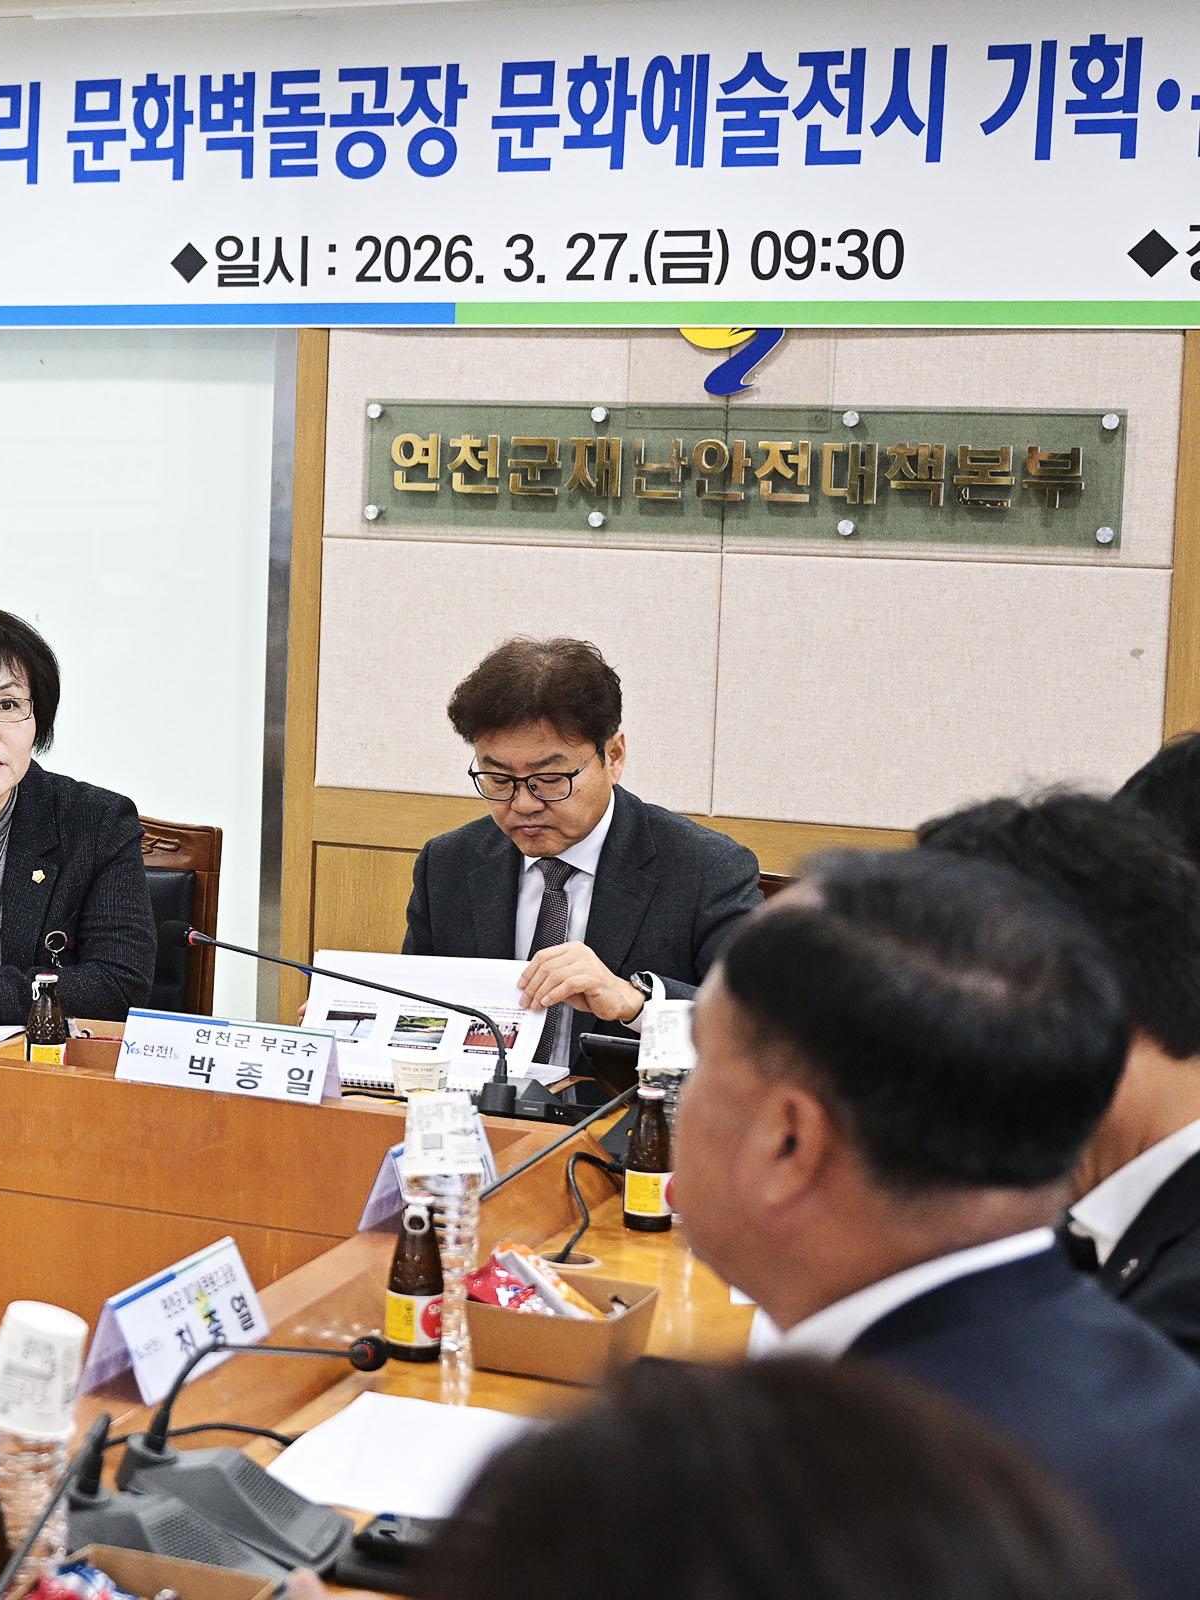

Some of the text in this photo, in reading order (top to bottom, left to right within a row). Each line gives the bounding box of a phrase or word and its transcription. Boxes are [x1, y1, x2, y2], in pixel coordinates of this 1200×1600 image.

[66, 64, 468, 183] 문화벽돌공장
[492, 45, 947, 172] 문화예술전시
[981, 35, 1200, 162] 기획·
[215, 236, 308, 287] 일시
[355, 235, 484, 284] 2026.
[504, 234, 546, 284] 3.
[750, 228, 905, 281] 09:30
[196, 1028, 319, 1057] 연천군 부군수
